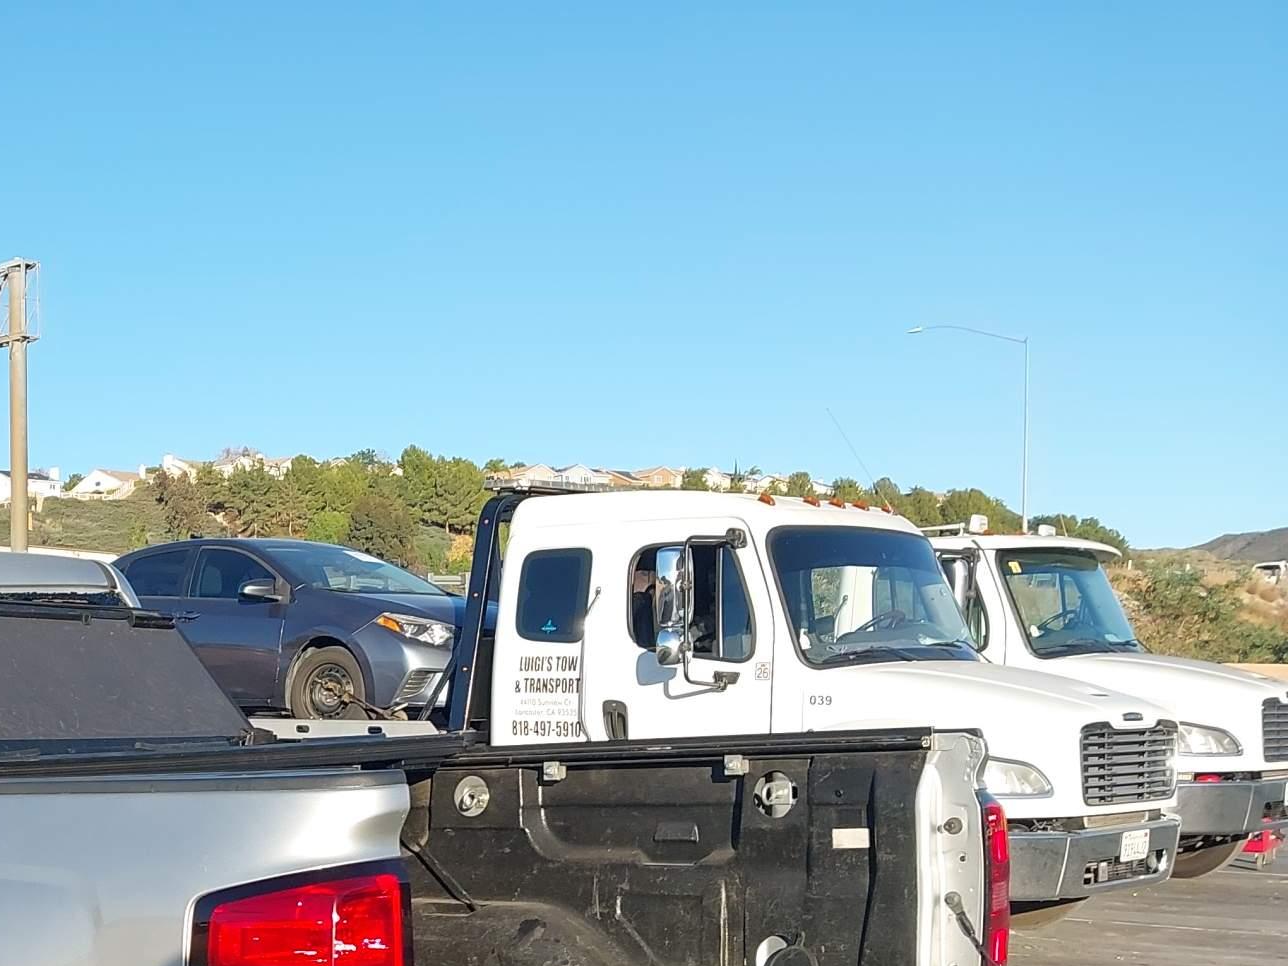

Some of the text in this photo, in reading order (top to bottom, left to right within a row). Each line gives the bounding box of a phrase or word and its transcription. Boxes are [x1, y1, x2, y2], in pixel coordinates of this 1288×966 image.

[519, 655, 578, 672] LUIGI'S TOW
[756, 667, 769, 679] 26
[514, 677, 580, 693] & TRANSPORT
[809, 695, 832, 706] 039
[512, 719, 582, 738] 818-497-5910
